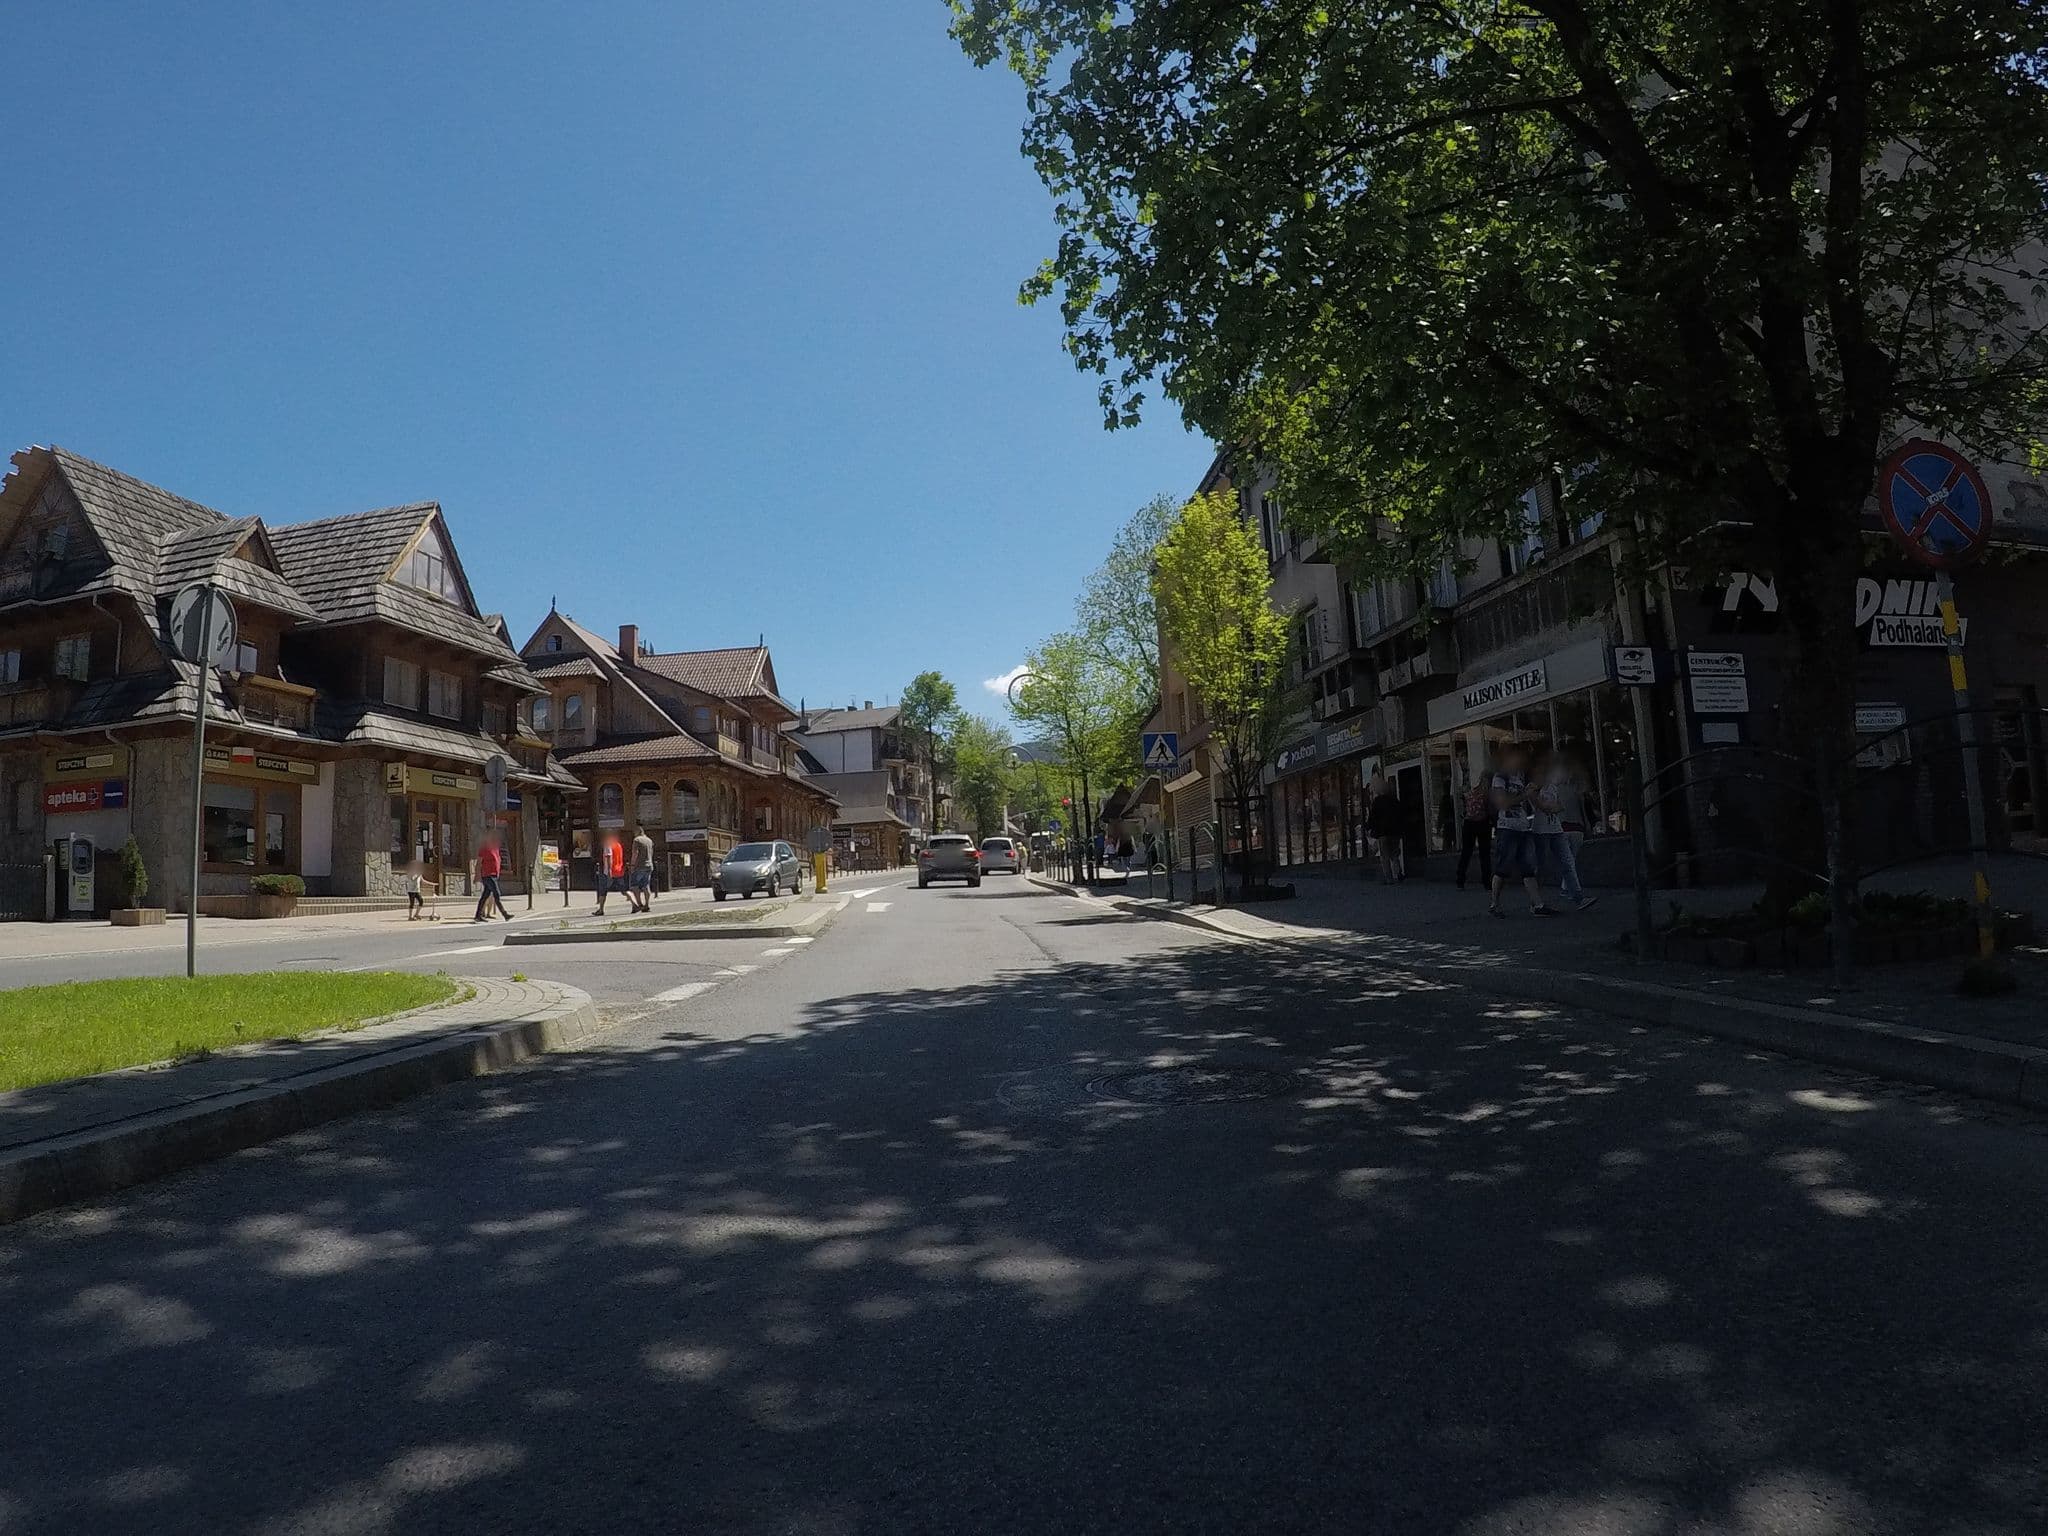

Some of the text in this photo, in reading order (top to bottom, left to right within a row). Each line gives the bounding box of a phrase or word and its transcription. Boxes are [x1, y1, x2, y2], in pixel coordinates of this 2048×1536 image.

[1463, 669, 1541, 710] MAISON STYLE
[47, 789, 88, 807] apteka
